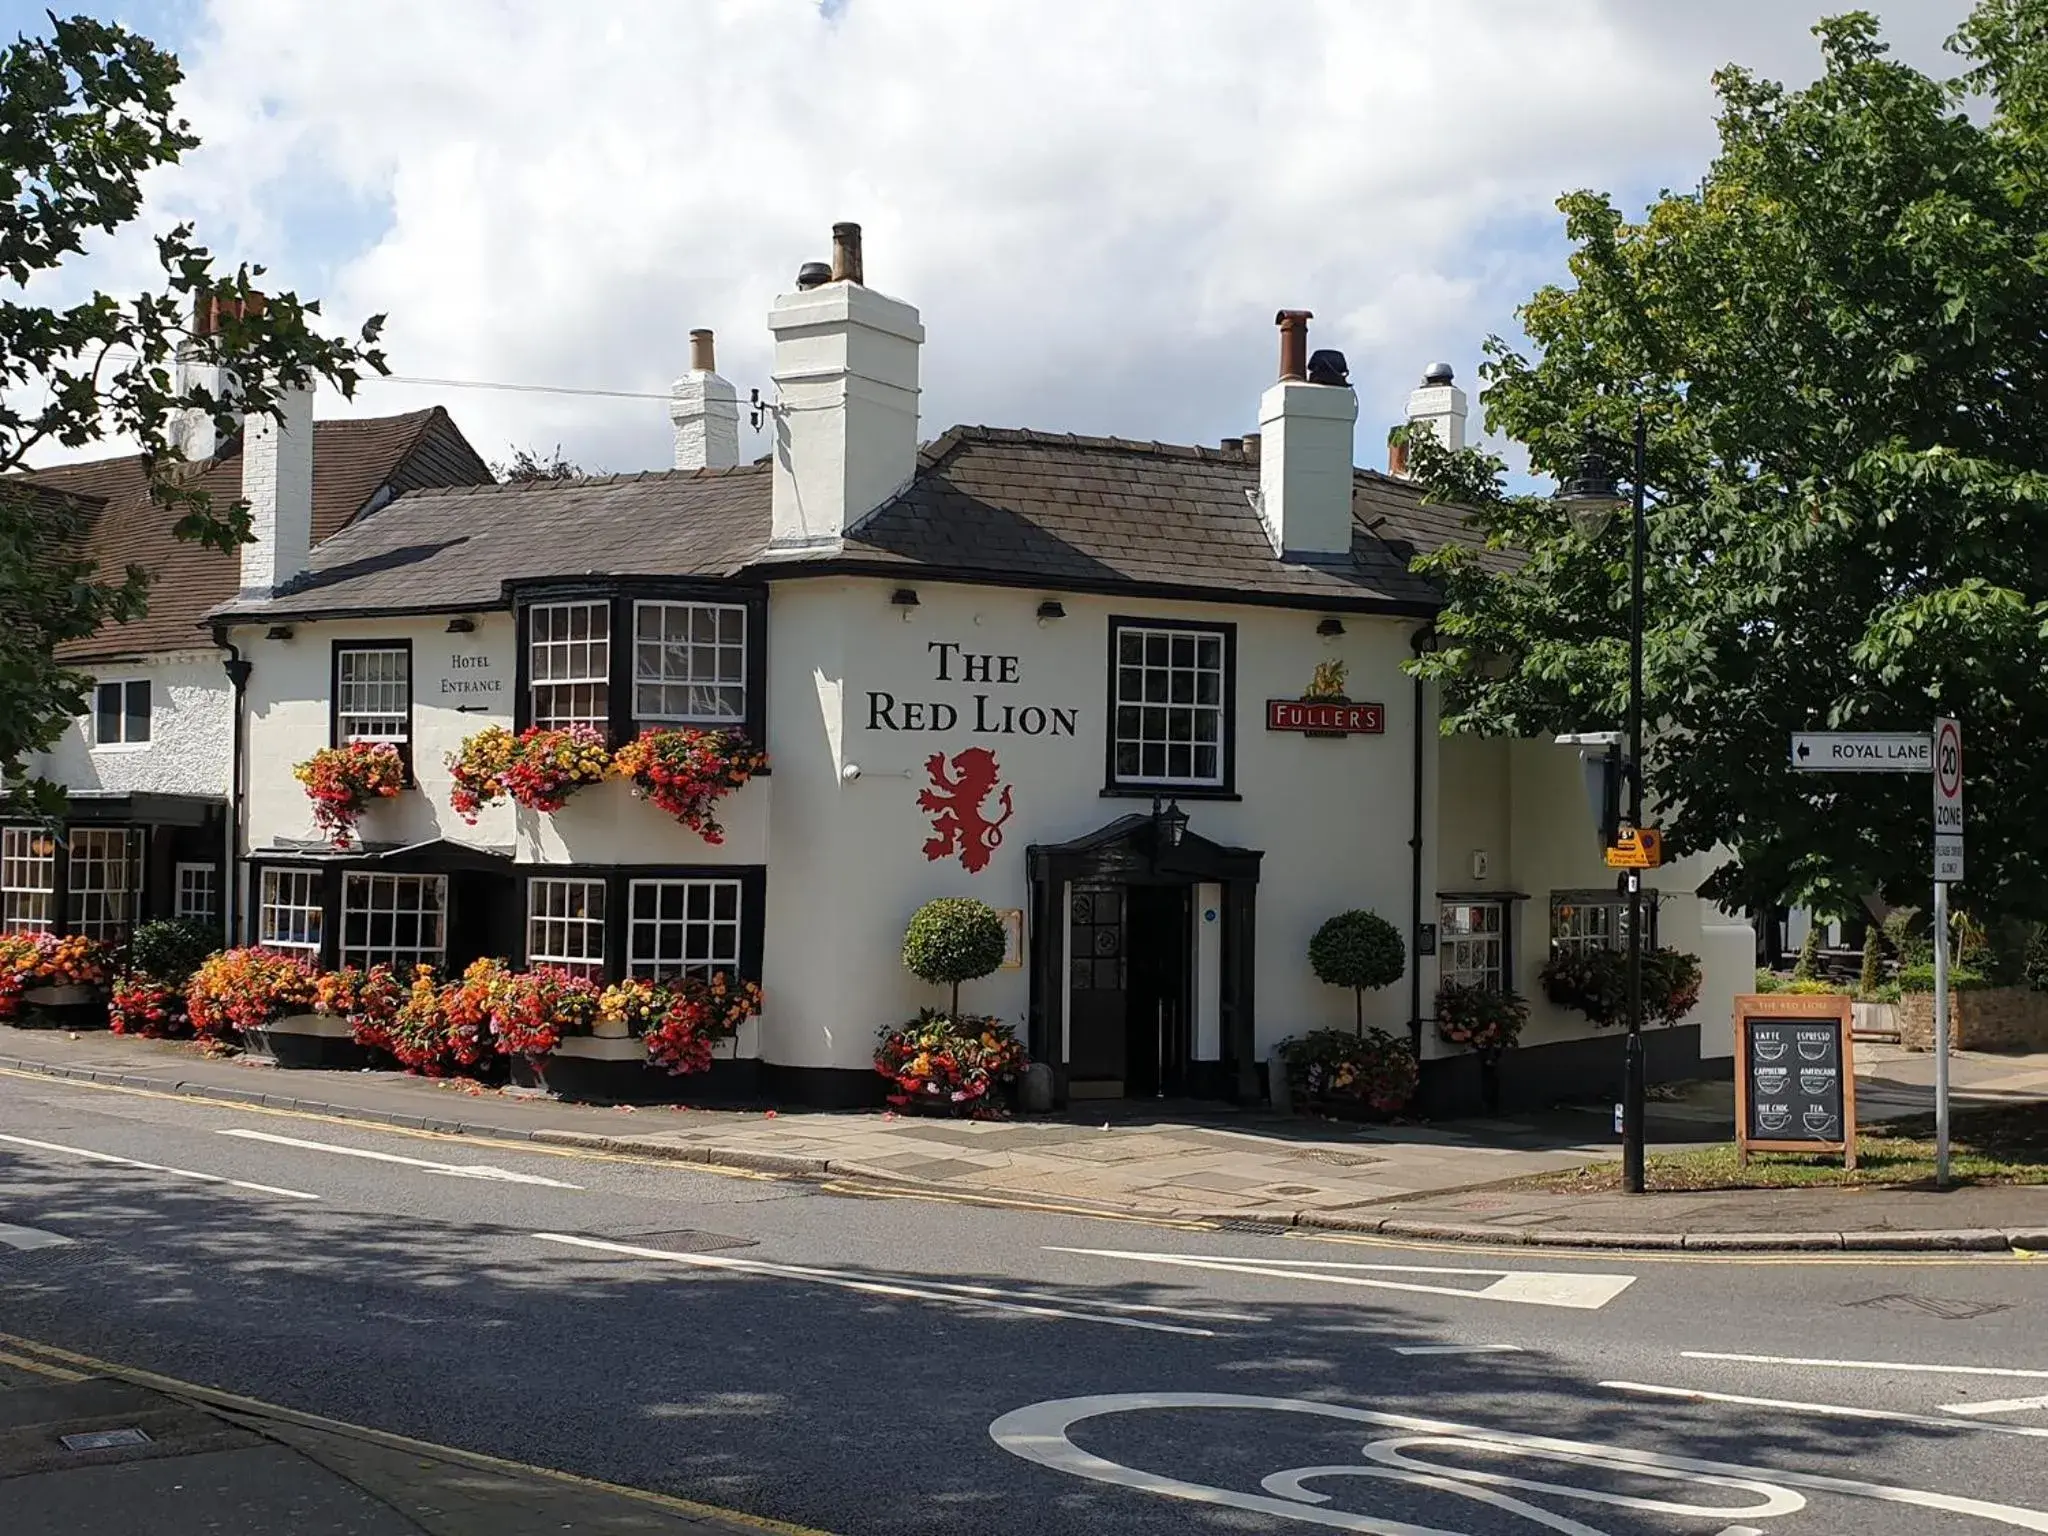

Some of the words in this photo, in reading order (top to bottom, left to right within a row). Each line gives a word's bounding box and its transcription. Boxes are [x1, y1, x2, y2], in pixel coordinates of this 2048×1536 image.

[452, 654, 491, 669] HOTEL
[927, 642, 1021, 683] THE
[440, 678, 502, 693] ENTRANCE
[865, 691, 958, 731] RED
[972, 694, 1080, 737] LION
[1276, 705, 1377, 728] FULLER'S
[1832, 744, 1883, 759] ROYAL
[1887, 744, 1929, 759] LANE
[1942, 745, 1957, 775] 20
[1937, 806, 1962, 826] ZONE
[1755, 1032, 1780, 1041] LATTE
[1797, 1032, 1831, 1041] ESPRESSO
[1810, 1104, 1824, 1113] TEA
